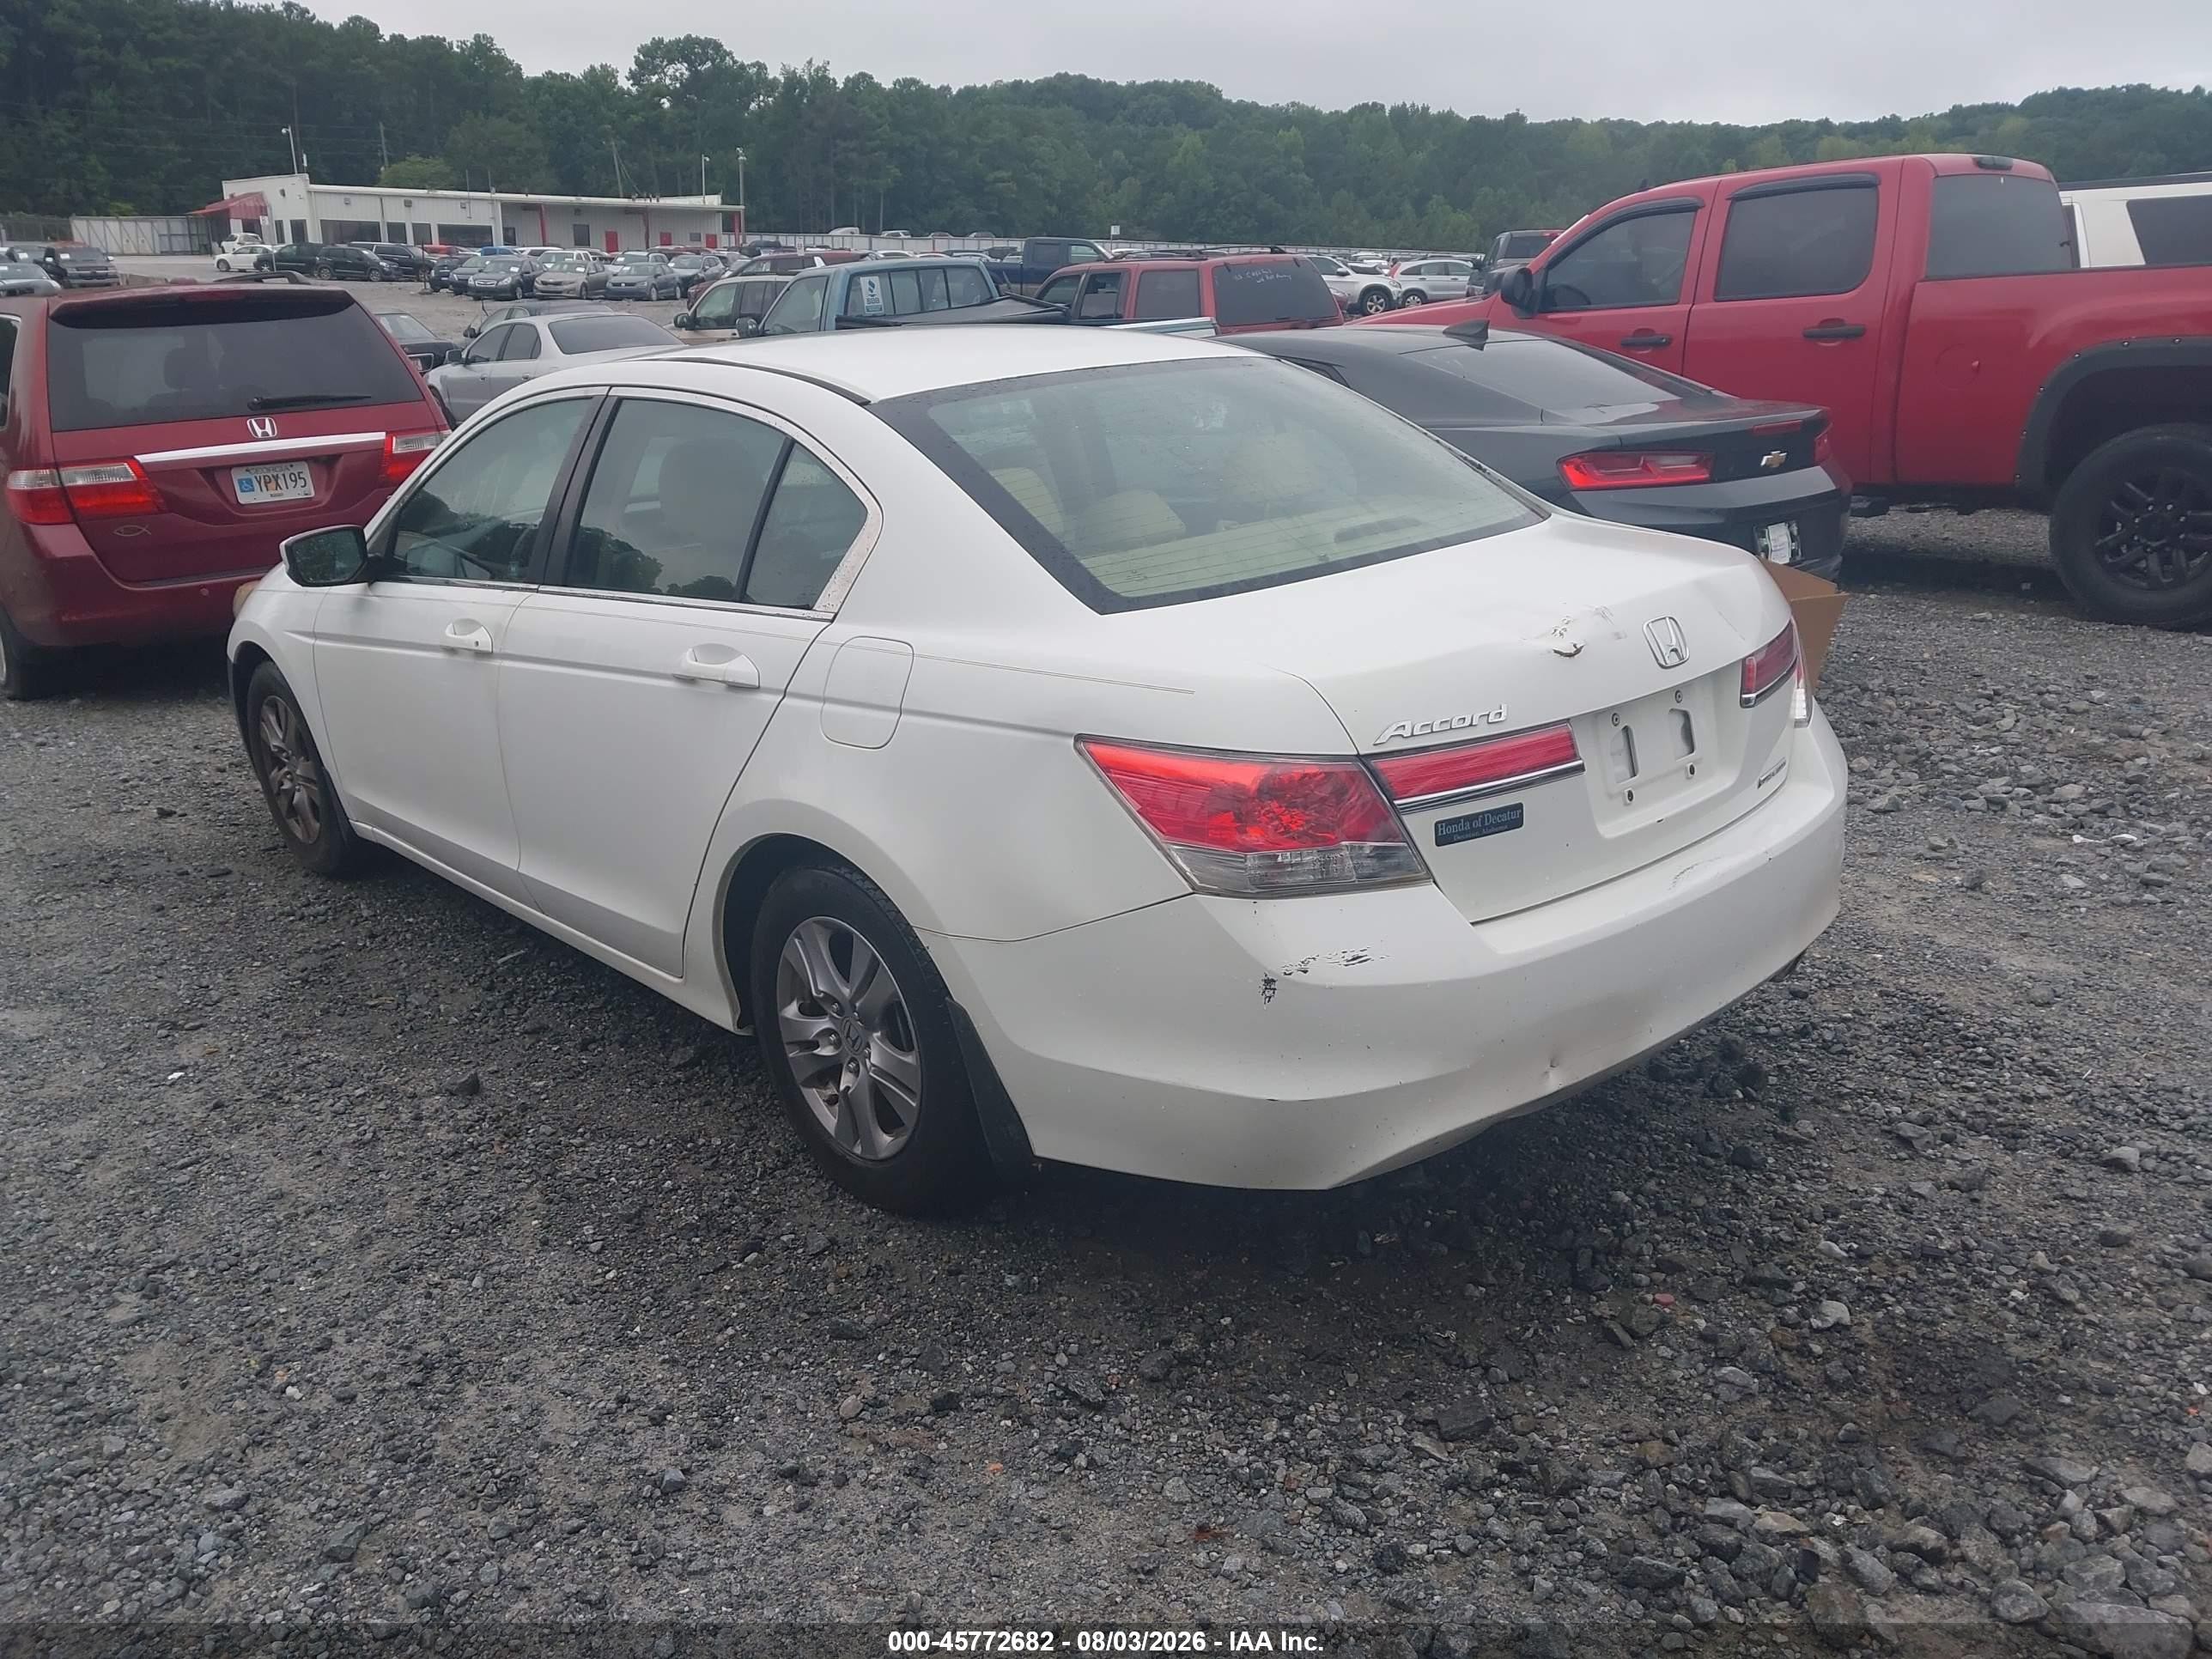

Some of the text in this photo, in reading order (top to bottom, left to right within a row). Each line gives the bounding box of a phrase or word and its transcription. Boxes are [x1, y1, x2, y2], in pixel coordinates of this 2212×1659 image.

[254, 471, 307, 492] YPX195
[1373, 703, 1508, 745] Accord
[1437, 809, 1522, 836] Honda of Decatur
